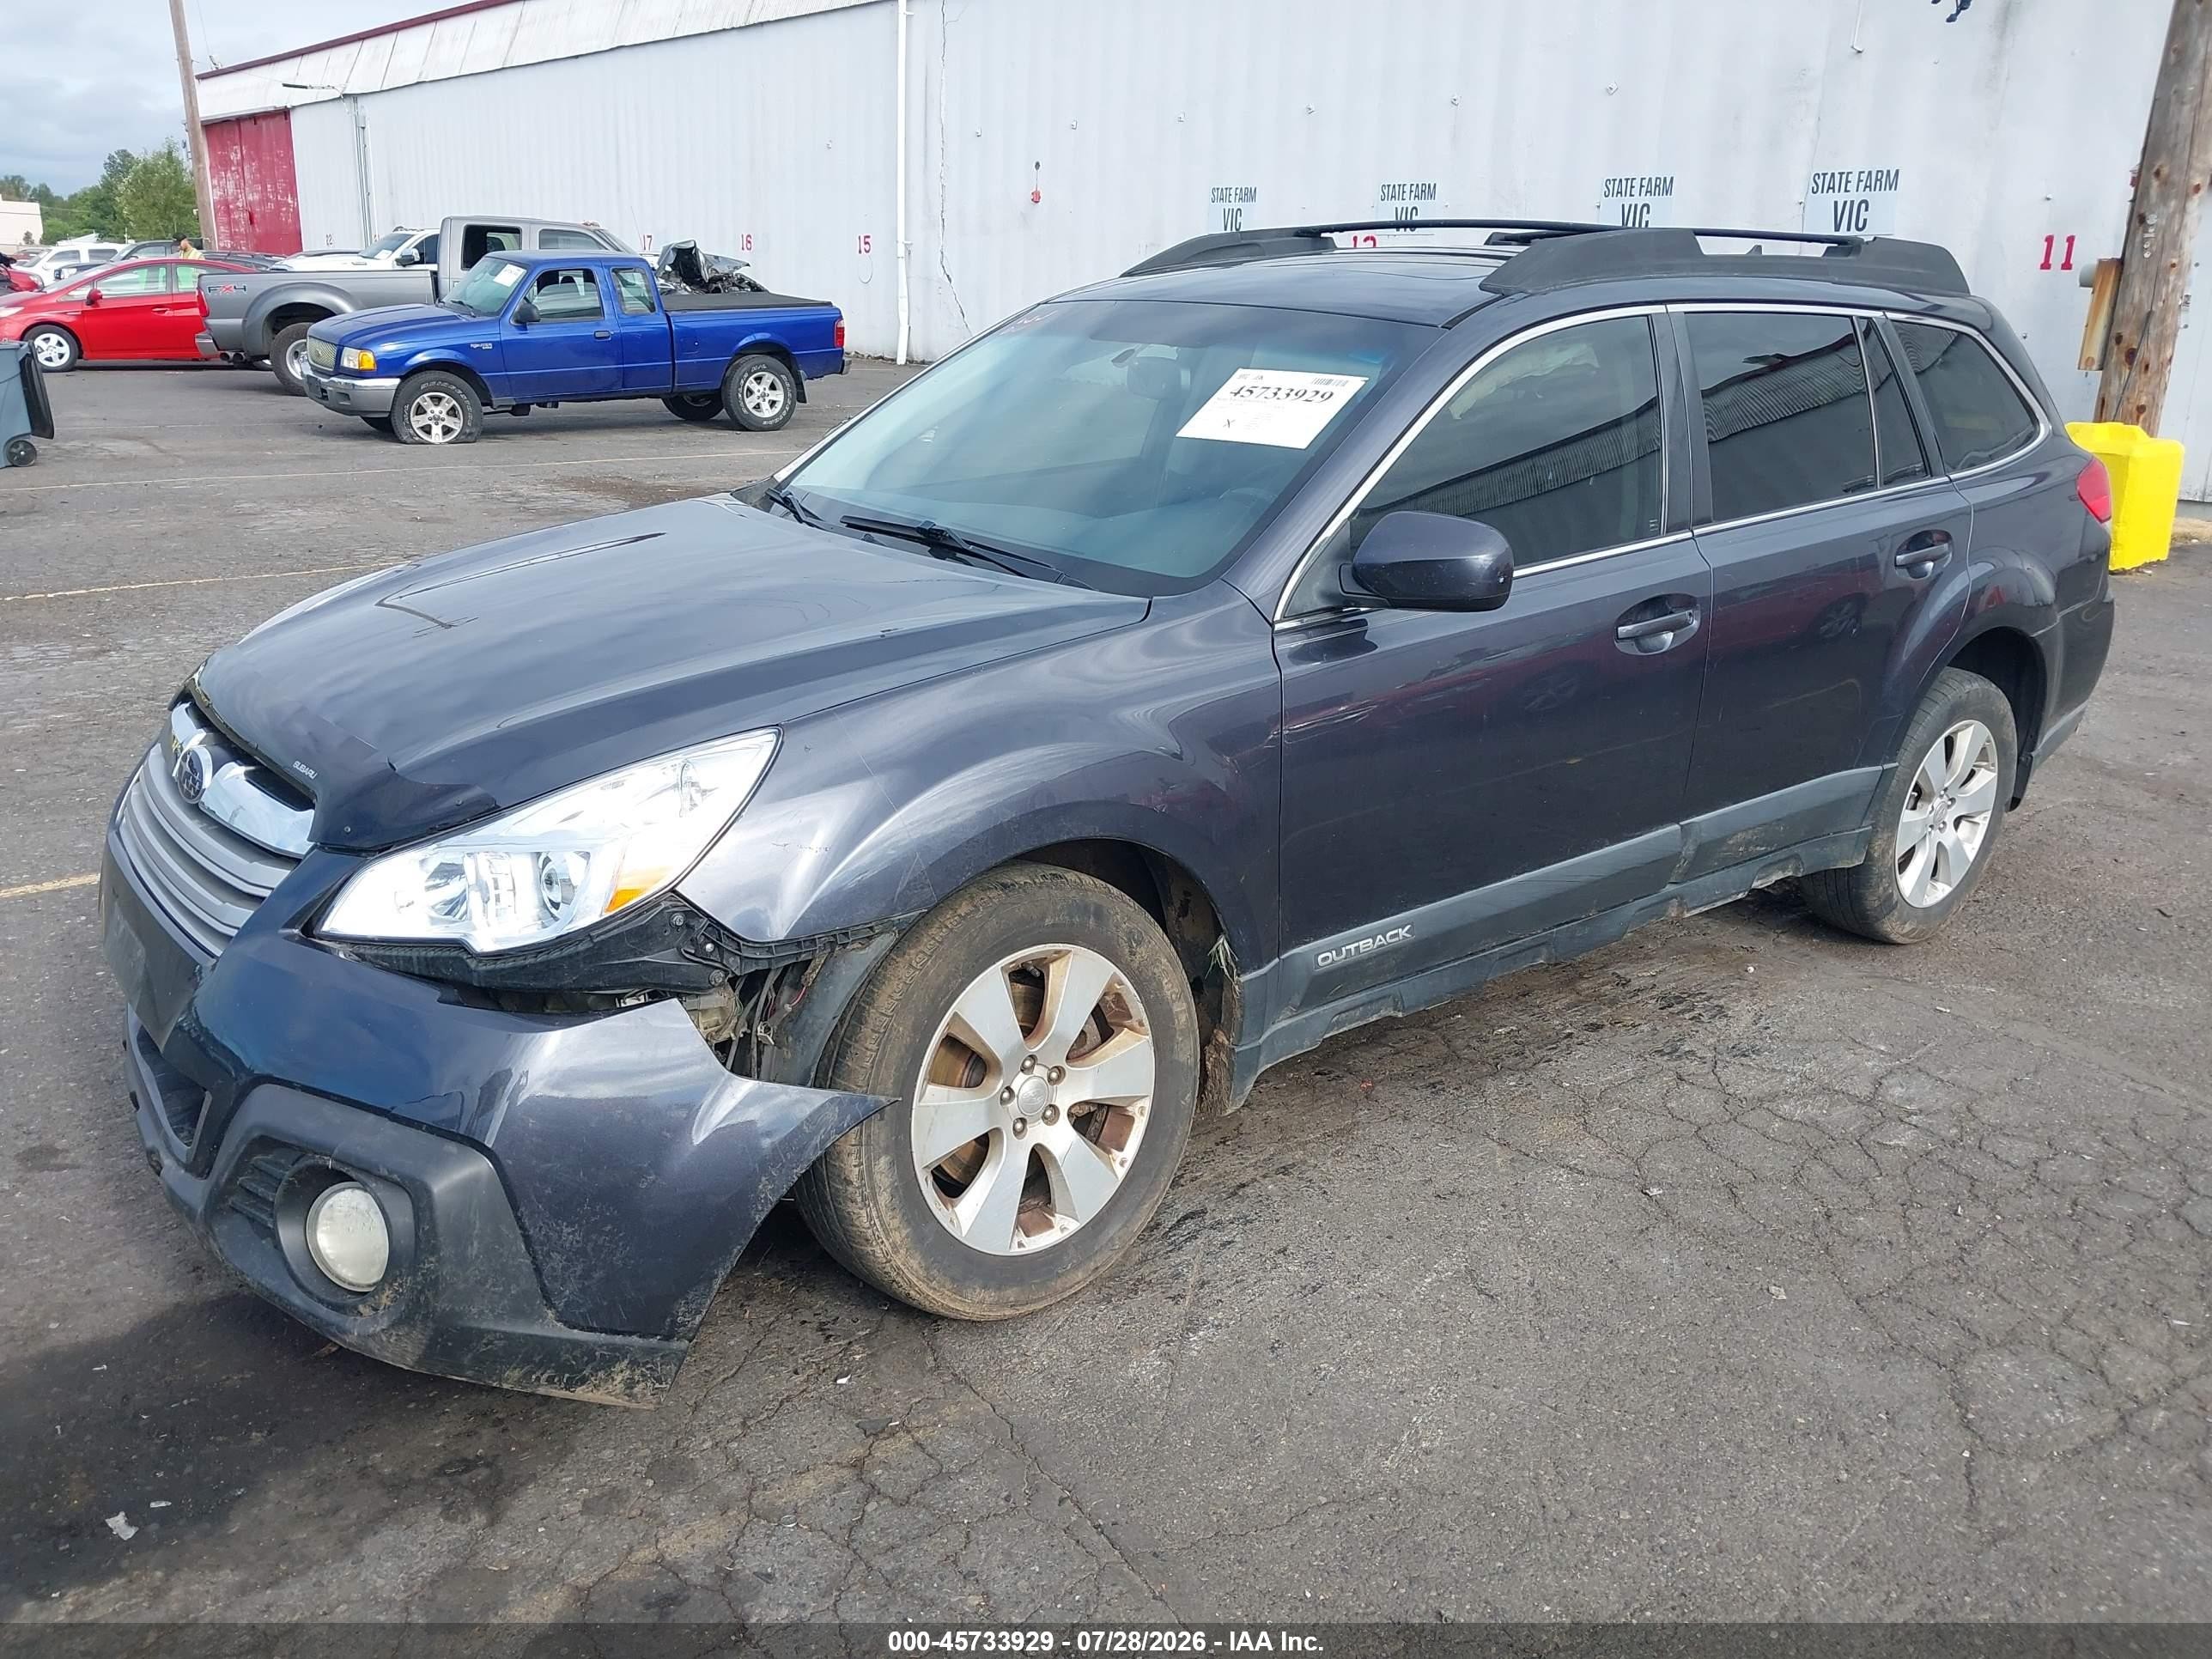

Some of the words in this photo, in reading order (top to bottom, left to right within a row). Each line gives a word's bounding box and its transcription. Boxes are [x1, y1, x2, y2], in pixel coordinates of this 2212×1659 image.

[1380, 184, 1407, 201] STATE
[1408, 183, 1437, 201] FARM
[1603, 178, 1637, 198] STATE
[1638, 176, 1674, 197] FARM
[1811, 172, 1853, 194] STATE
[1856, 169, 1899, 192] FARM
[1211, 186, 1232, 203] STATE
[1234, 186, 1257, 203] FARM
[1223, 208, 1243, 231] VIC
[1395, 206, 1419, 232] VIC
[1621, 203, 1650, 228] VIC
[1833, 199, 1869, 232] VIC
[642, 234, 653, 250] 17
[741, 234, 753, 251] 16
[858, 234, 872, 254] 15
[2039, 234, 2075, 270] 11
[208, 284, 246, 294] FX4
[1229, 385, 1335, 404] 45733929
[293, 760, 318, 780] SUBARU
[1317, 924, 1413, 967] OUTBACK
